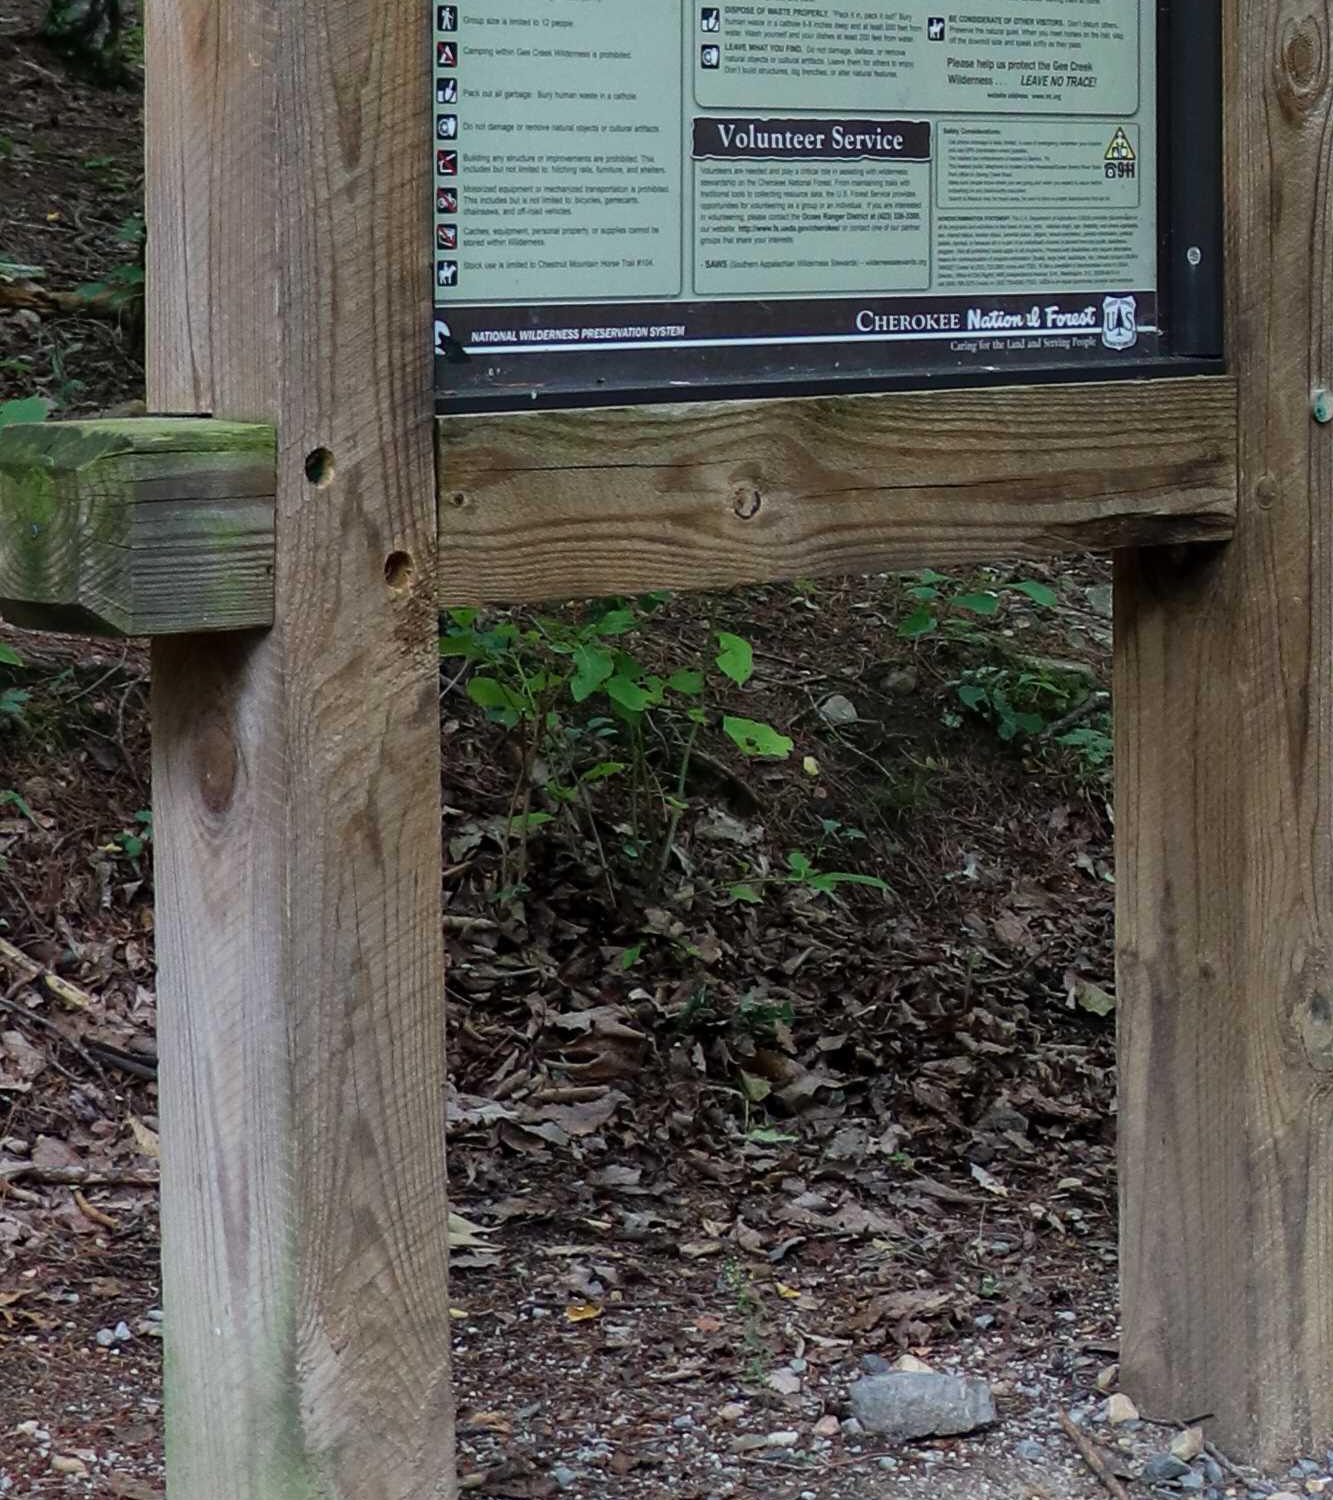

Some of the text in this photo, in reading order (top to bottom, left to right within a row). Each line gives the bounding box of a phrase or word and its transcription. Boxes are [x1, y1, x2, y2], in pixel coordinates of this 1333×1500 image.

[948, 58, 1092, 72] Please help us protect the Gee Creek
[1021, 76, 1096, 87] LEAVE NO TRACE!
[718, 124, 904, 150] Volunteer Service
[856, 310, 960, 332] CHEROKEE
[1046, 306, 1096, 328] Forest
[472, 325, 685, 341] NATIONAL WILDERNESS PRESERVATION SYSTEM
[951, 336, 1096, 351] Caring for the Land and Serving People
